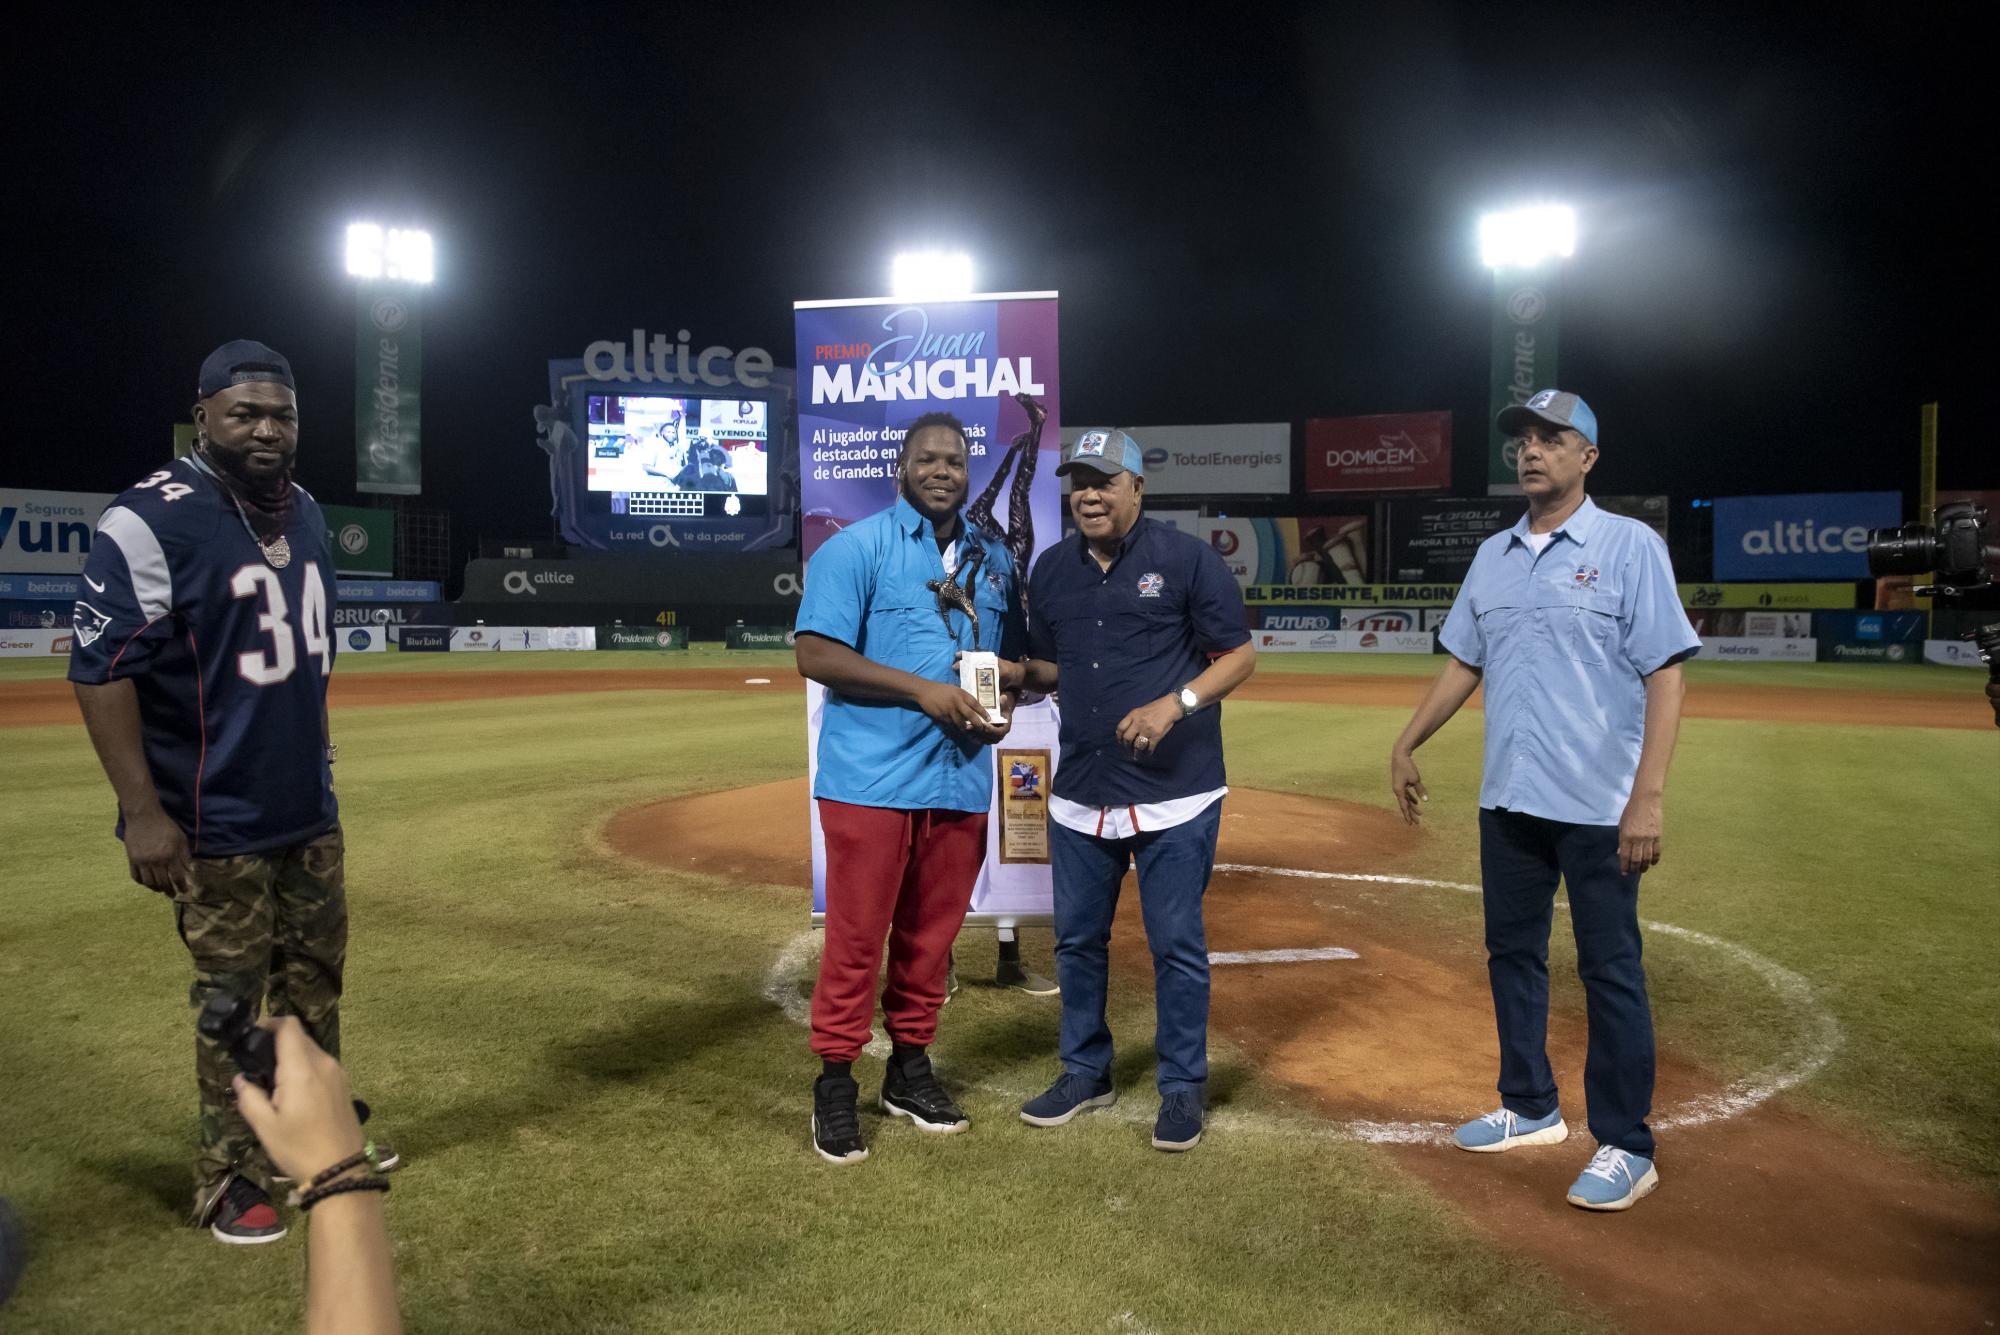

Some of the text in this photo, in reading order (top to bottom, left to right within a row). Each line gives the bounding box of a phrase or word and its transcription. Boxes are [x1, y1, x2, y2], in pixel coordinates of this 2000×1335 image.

[866, 306, 985, 376] Juan
[583, 328, 774, 388] altice
[815, 343, 872, 360] PREMIO
[811, 357, 1045, 404] MARICHAL
[369, 338, 399, 471] Presidente
[733, 418, 758, 426] POPULAR
[713, 429, 754, 437] UYENDO
[813, 430, 826, 444] Al
[829, 427, 878, 448] jugador
[813, 444, 878, 462] destacado
[880, 448, 897, 459] en
[1172, 451, 1283, 469] TotalEnergies
[1326, 448, 1415, 467] DOMICEM
[814, 467, 829, 480] de
[832, 463, 884, 479] Grandes
[134, 470, 195, 502] 34
[24, 502, 85, 517] Seguros
[611, 529, 624, 540] La
[626, 529, 645, 540] red
[684, 530, 695, 541] te
[697, 531, 711, 541] da
[714, 530, 746, 543] poder
[1408, 538, 1442, 547] AHORA
[1445, 537, 1458, 546] EN
[1462, 536, 1473, 545] TU
[1742, 519, 1869, 555] altice
[534, 571, 575, 585] altice
[27, 581, 78, 593] betcris
[337, 586, 374, 597] etcris
[386, 586, 428, 597] betcris
[1245, 586, 1456, 604] EL PRESENTE, IMAGIN
[230, 560, 331, 688] 34
[655, 611, 677, 626] 411
[611, 632, 655, 644] Presidente
[741, 631, 783, 643] Presidente
[0, 641, 34, 649] Crecer
[1718, 645, 1759, 656] betcris
[1834, 644, 1886, 656] Presidente
